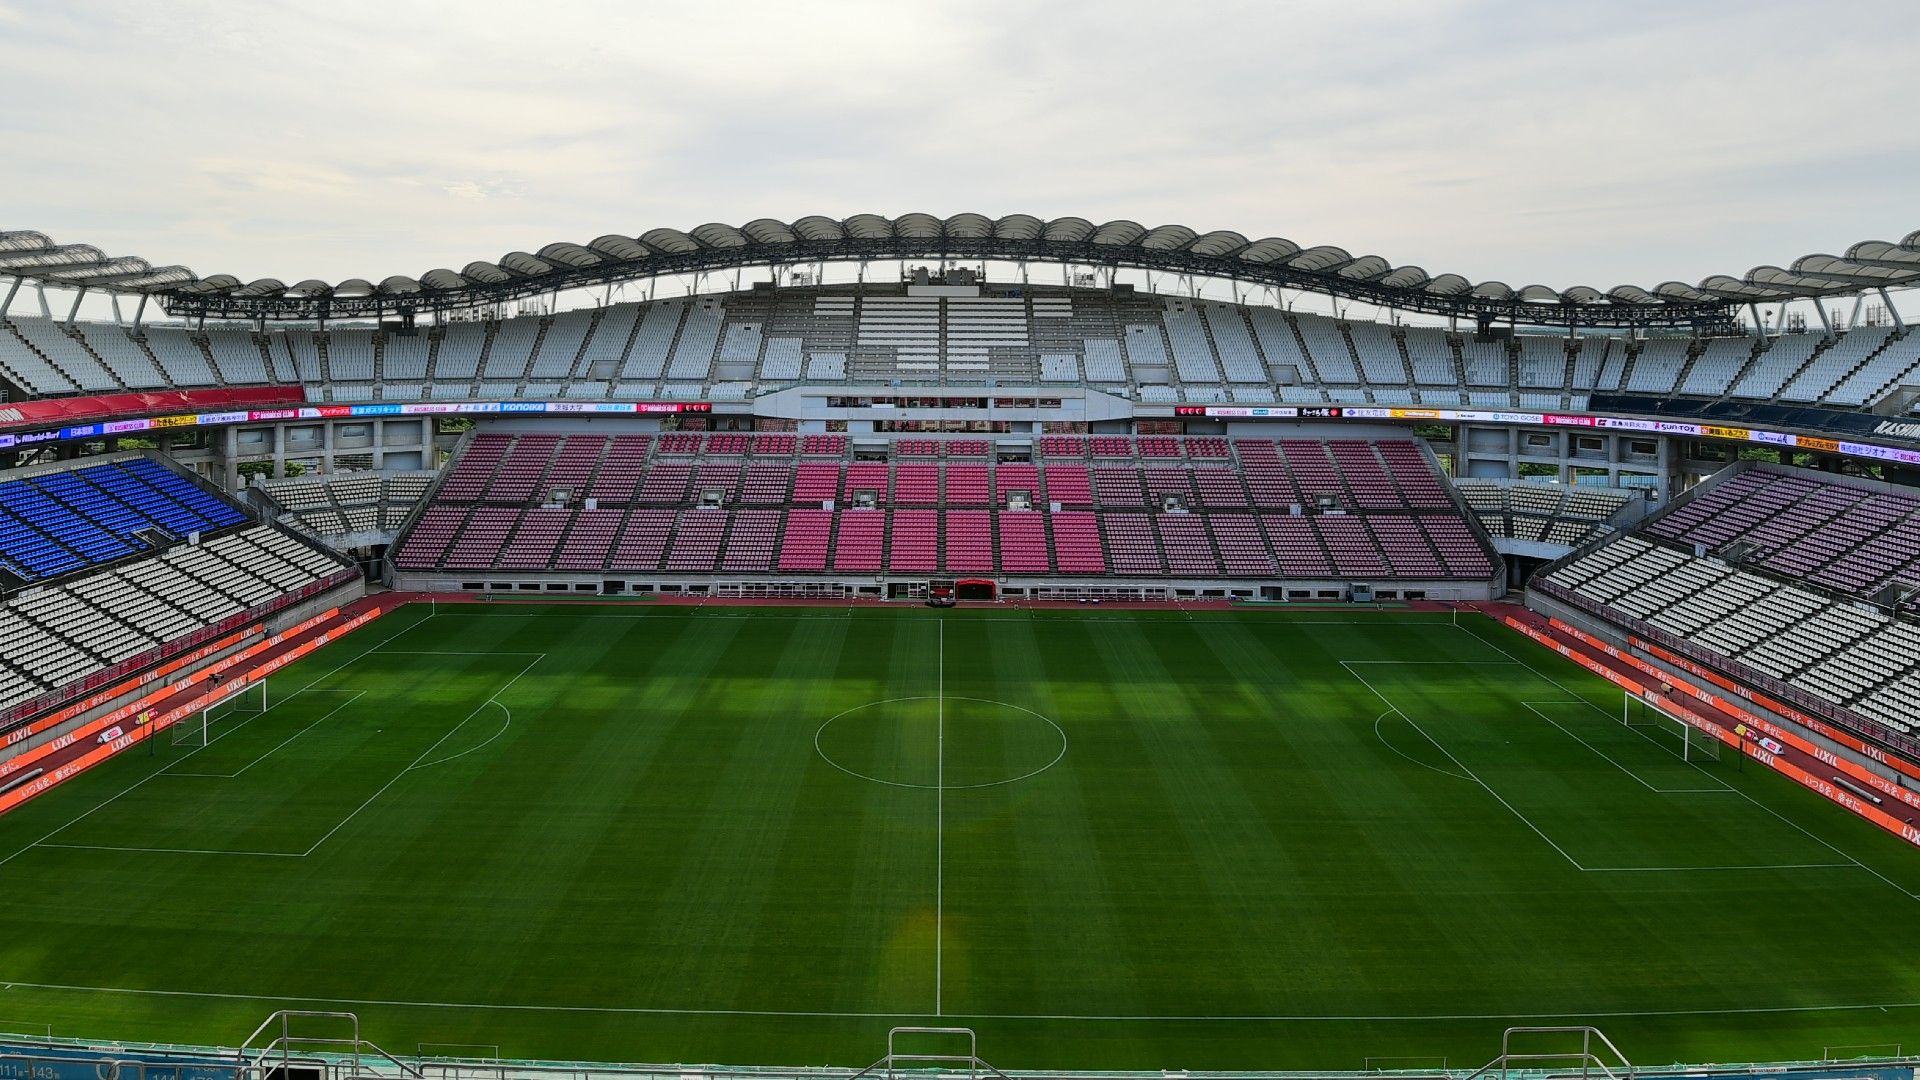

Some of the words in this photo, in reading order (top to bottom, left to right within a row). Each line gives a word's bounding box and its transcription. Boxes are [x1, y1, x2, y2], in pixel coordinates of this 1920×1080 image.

[140, 671, 158, 685] LIXIL
[174, 677, 193, 692] LIXIL
[226, 677, 244, 692] LIXIL
[1695, 688, 1714, 705] LIXIL
[1733, 684, 1753, 700] LIXIL
[7, 726, 33, 745] LIXIL
[51, 733, 76, 750] LIXIL
[111, 734, 134, 751] LIXIL
[1752, 747, 1776, 767] LIXIL
[1814, 747, 1838, 766] LIXIL
[1861, 743, 1888, 764] LIXIL
